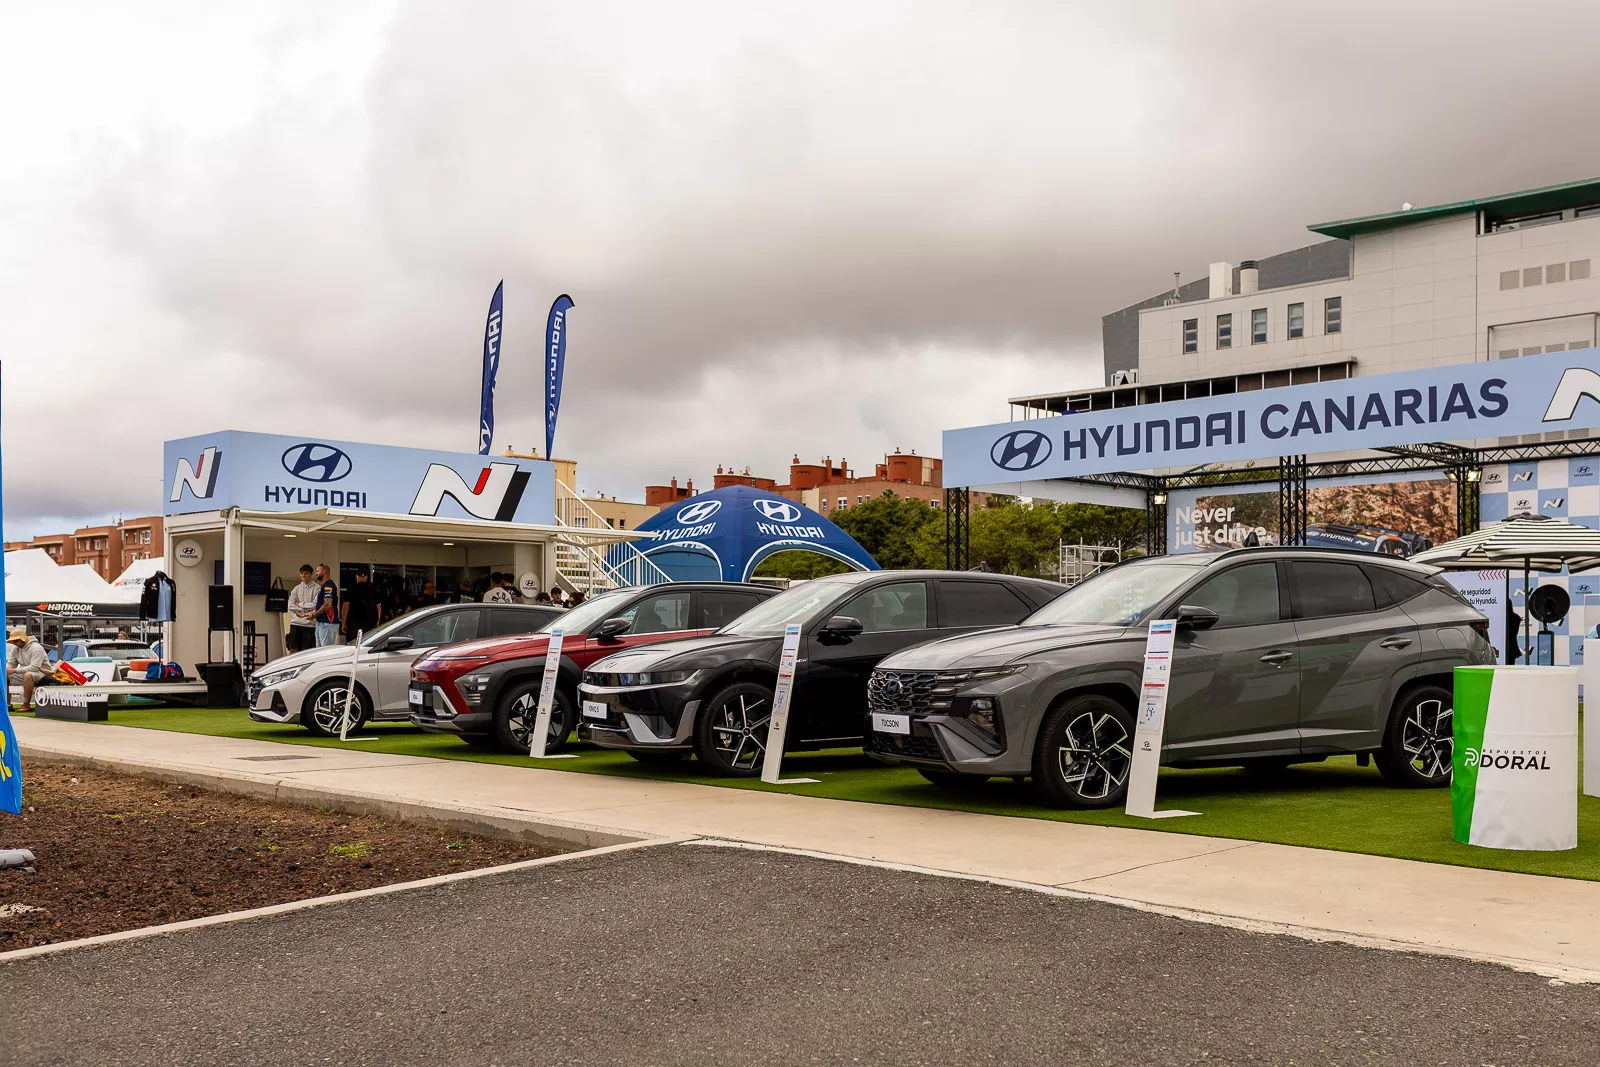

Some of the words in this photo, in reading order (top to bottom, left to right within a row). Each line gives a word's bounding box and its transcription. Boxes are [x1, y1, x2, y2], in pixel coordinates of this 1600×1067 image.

[1064, 410, 1246, 461] HYUNDAI
[1260, 379, 1509, 440] CANARIAS
[265, 485, 367, 509] HYUNDAI
[1175, 506, 1235, 525] Never
[652, 522, 716, 541] HYUNDAI
[756, 521, 826, 539] HYUNDAI
[1174, 525, 1211, 550] just
[1320, 532, 1354, 543] HYUNDAI
[1467, 587, 1491, 597] seguridad
[881, 718, 900, 728] TUCSON
[1480, 754, 1551, 770] DORAL
